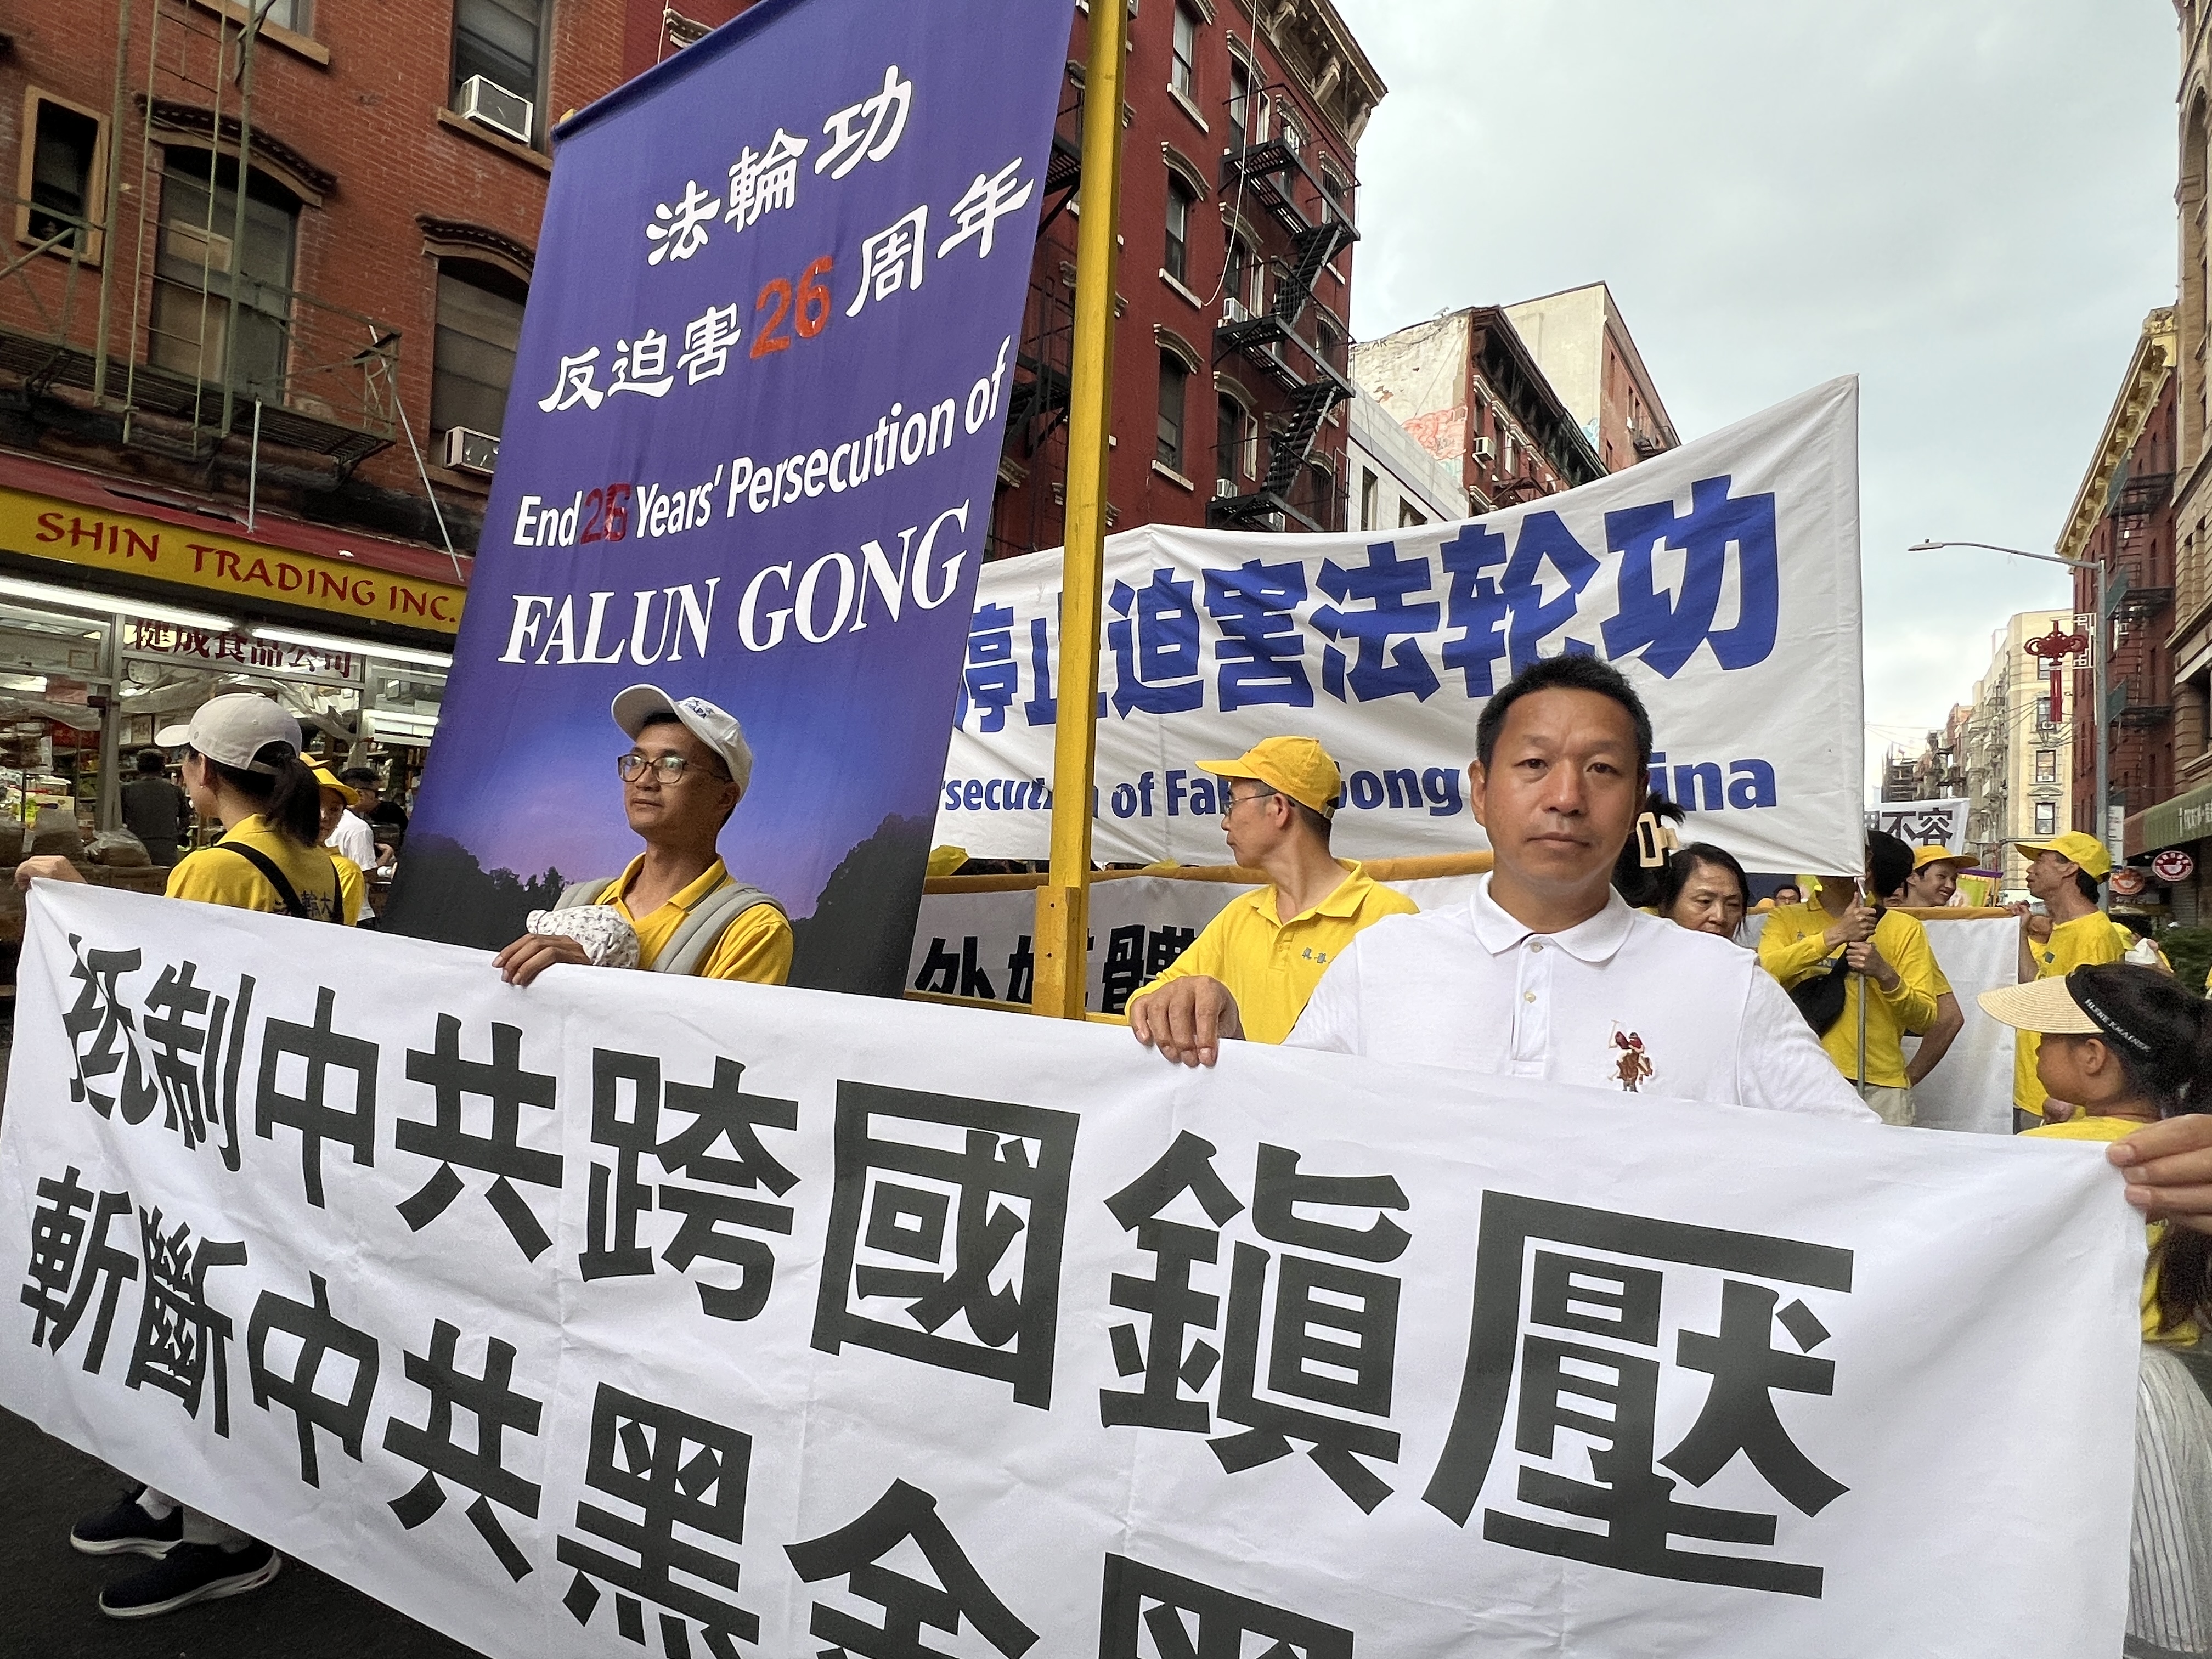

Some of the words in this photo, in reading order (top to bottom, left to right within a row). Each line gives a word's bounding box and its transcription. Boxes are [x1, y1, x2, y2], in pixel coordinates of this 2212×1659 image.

[647, 65, 913, 264] 法輪功
[514, 490, 583, 546] End
[726, 402, 956, 518] Persecution
[964, 335, 1011, 435] of
[35, 512, 159, 562] SHIN
[186, 544, 375, 607] TRADING
[388, 586, 456, 623] INC.
[498, 577, 722, 666] FALUN
[737, 498, 970, 653] GONG
[133, 620, 352, 678] 健成食品公司
[1111, 771, 1154, 819] of
[1338, 767, 1463, 816] ong
[1647, 752, 1776, 811] ina
